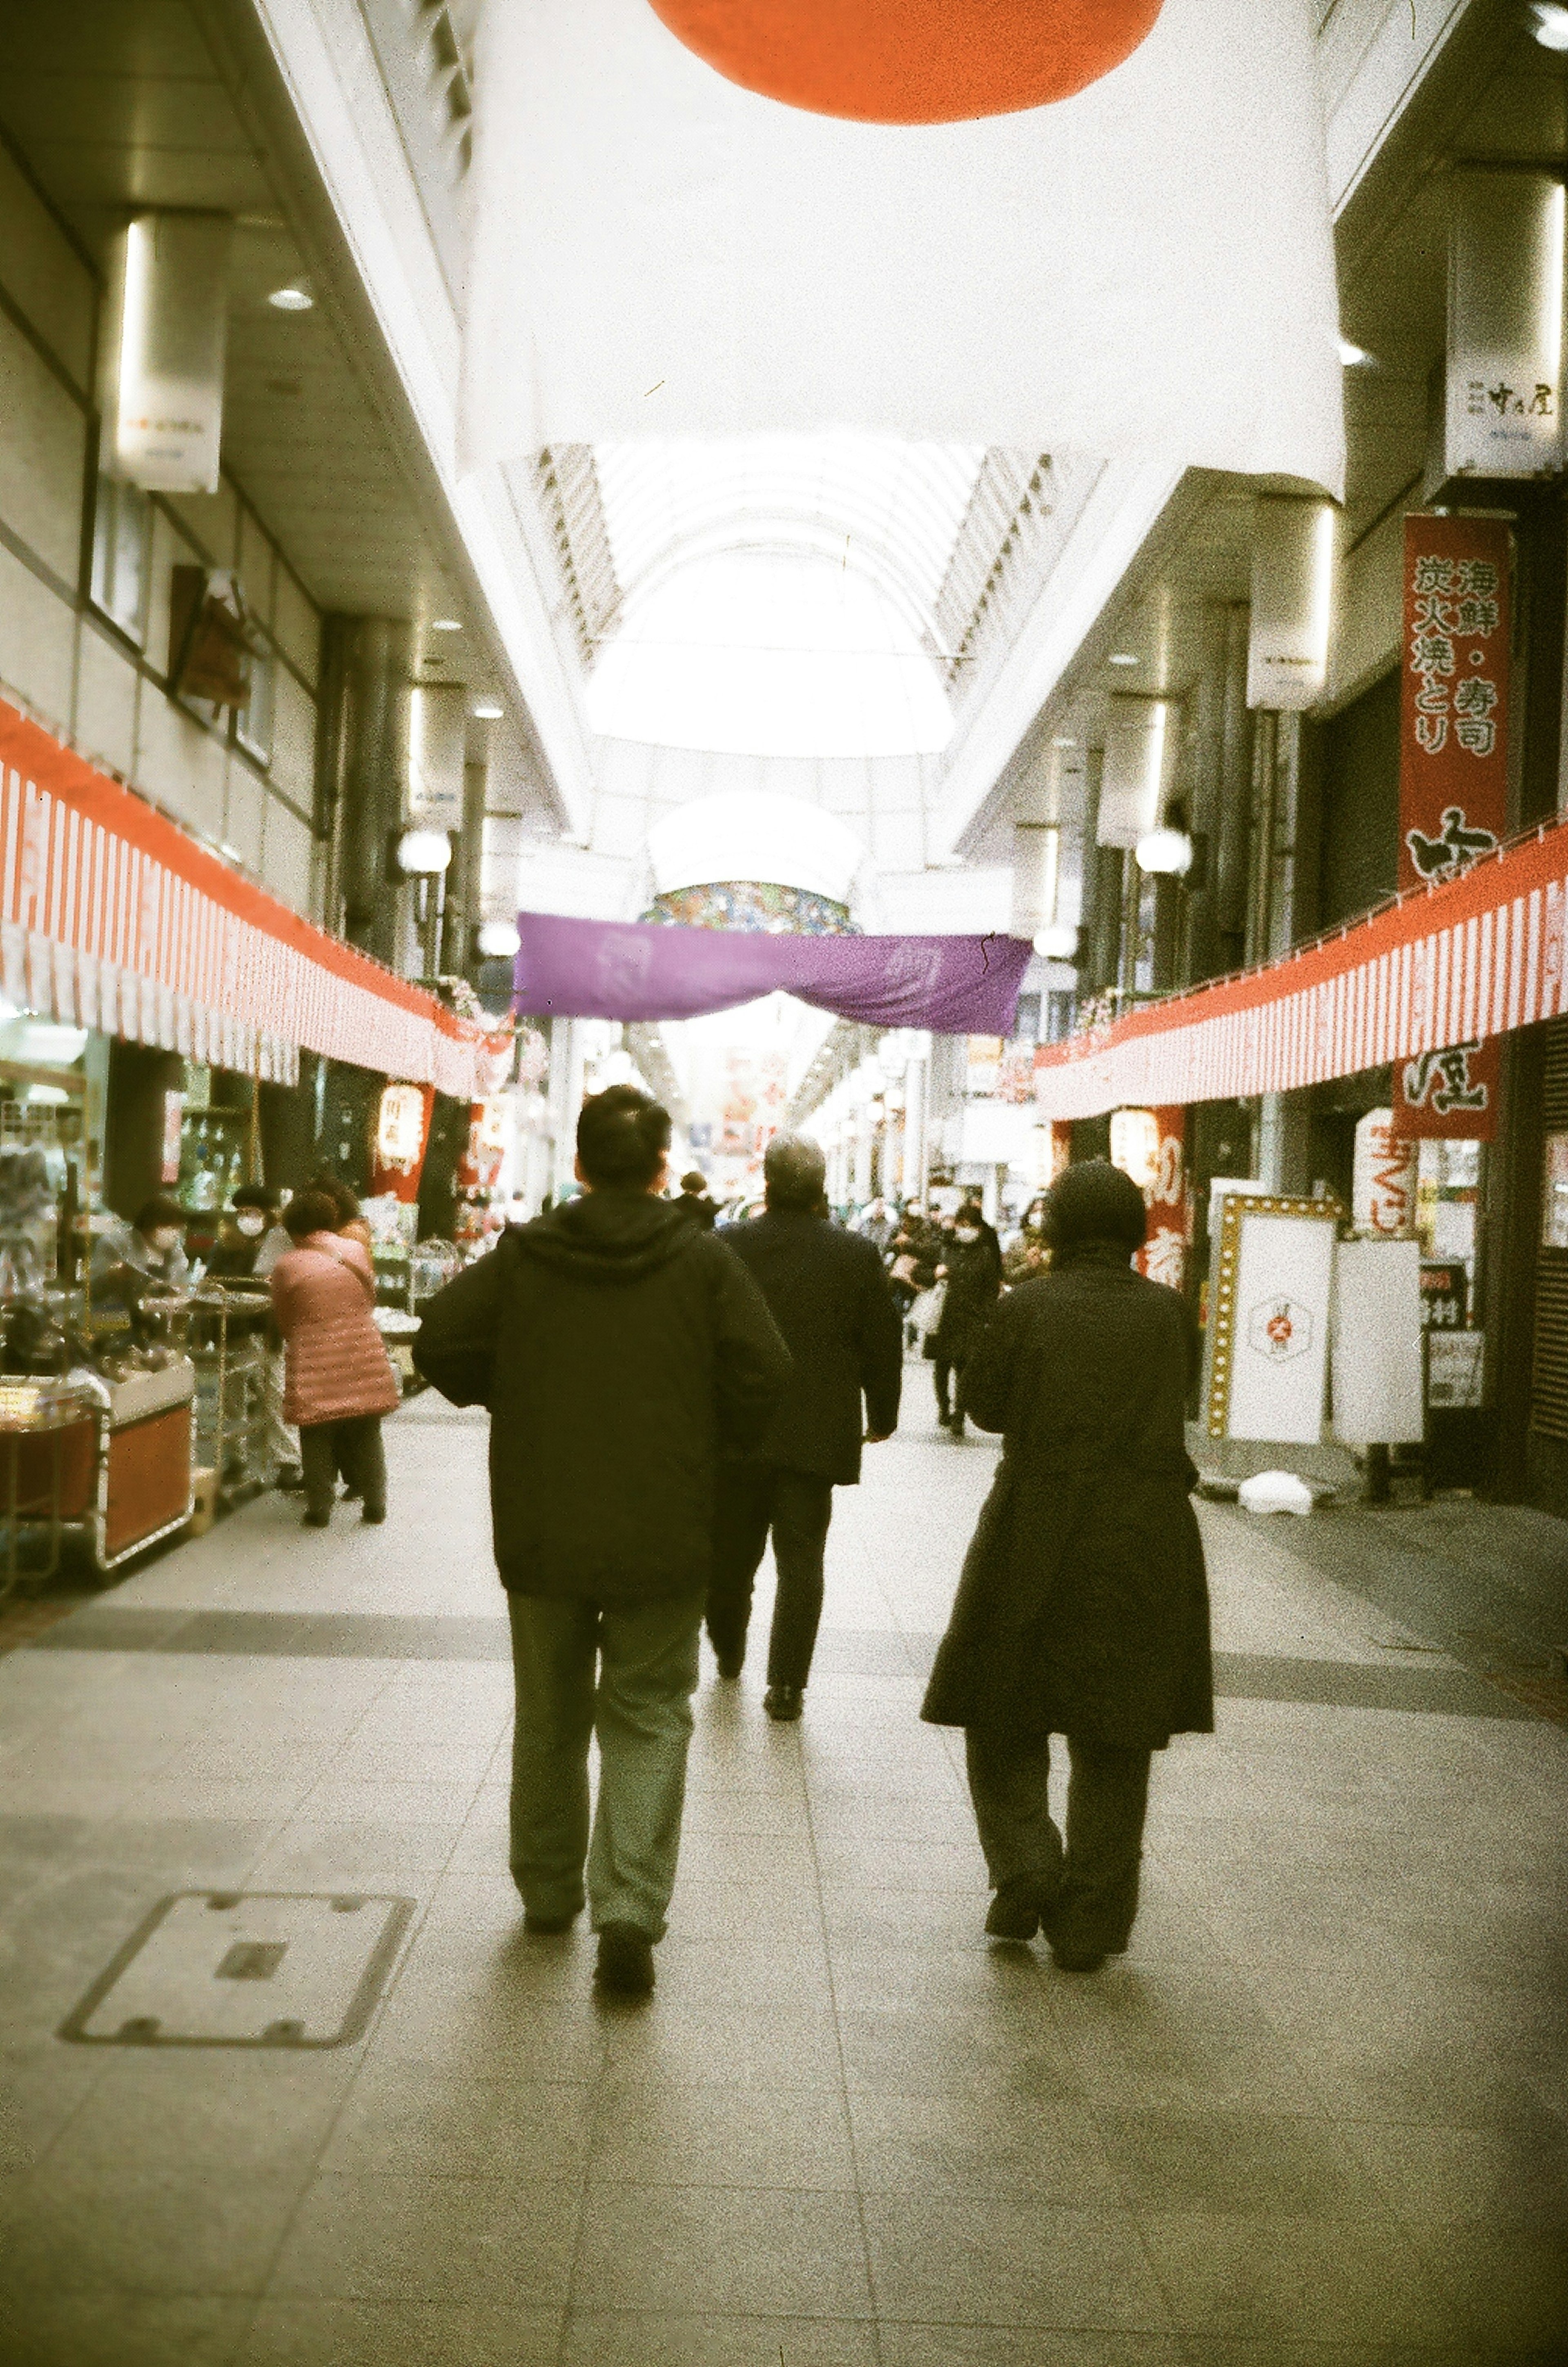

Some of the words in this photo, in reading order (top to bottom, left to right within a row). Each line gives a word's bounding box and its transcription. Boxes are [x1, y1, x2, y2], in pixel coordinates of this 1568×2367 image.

[1411, 555, 1455, 754] 炭火焼とり
[1454, 557, 1500, 758] 海鮮・寿司
